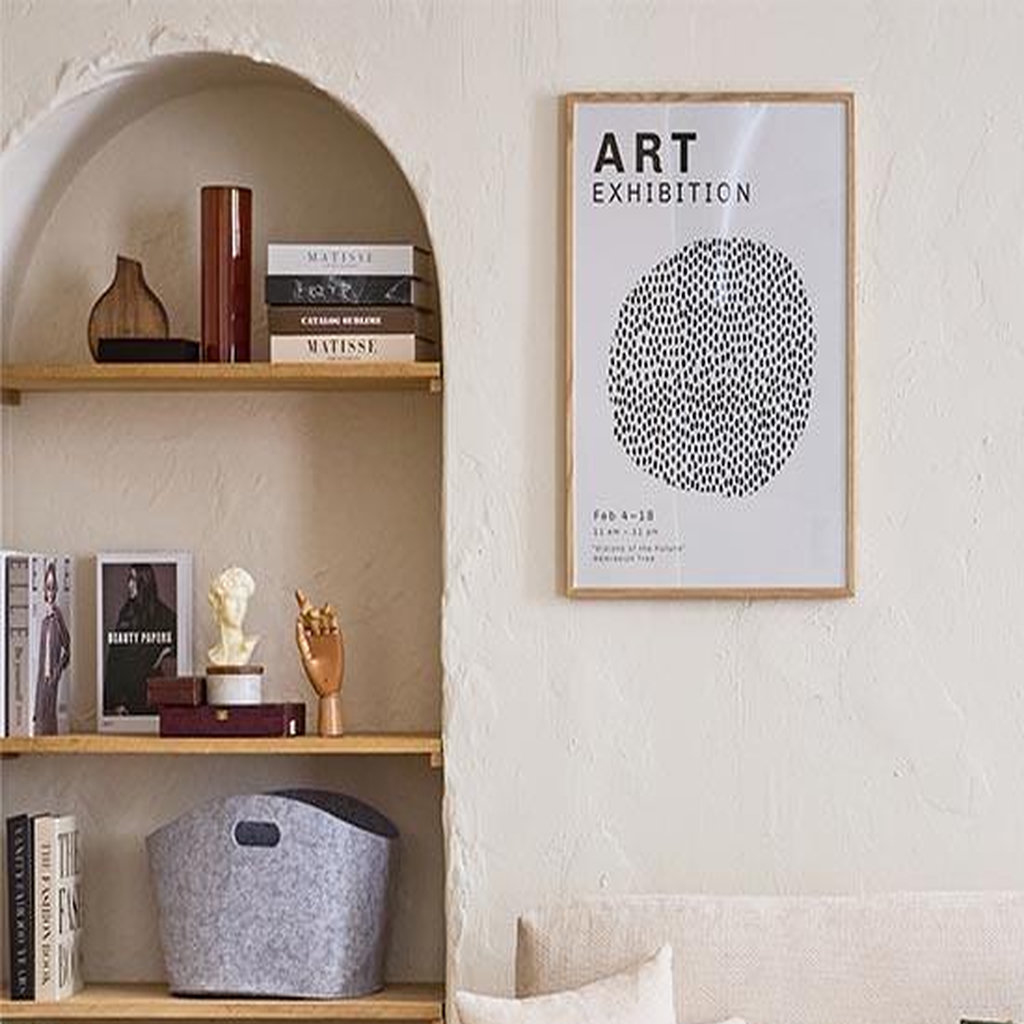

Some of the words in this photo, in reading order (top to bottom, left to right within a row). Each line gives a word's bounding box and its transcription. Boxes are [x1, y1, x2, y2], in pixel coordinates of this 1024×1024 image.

[594, 132, 697, 173] ART
[592, 182, 750, 203] EXHIBITION
[307, 339, 377, 354] MATISSE
[593, 509, 616, 521] Feb
[107, 632, 139, 645] BEAUTY
